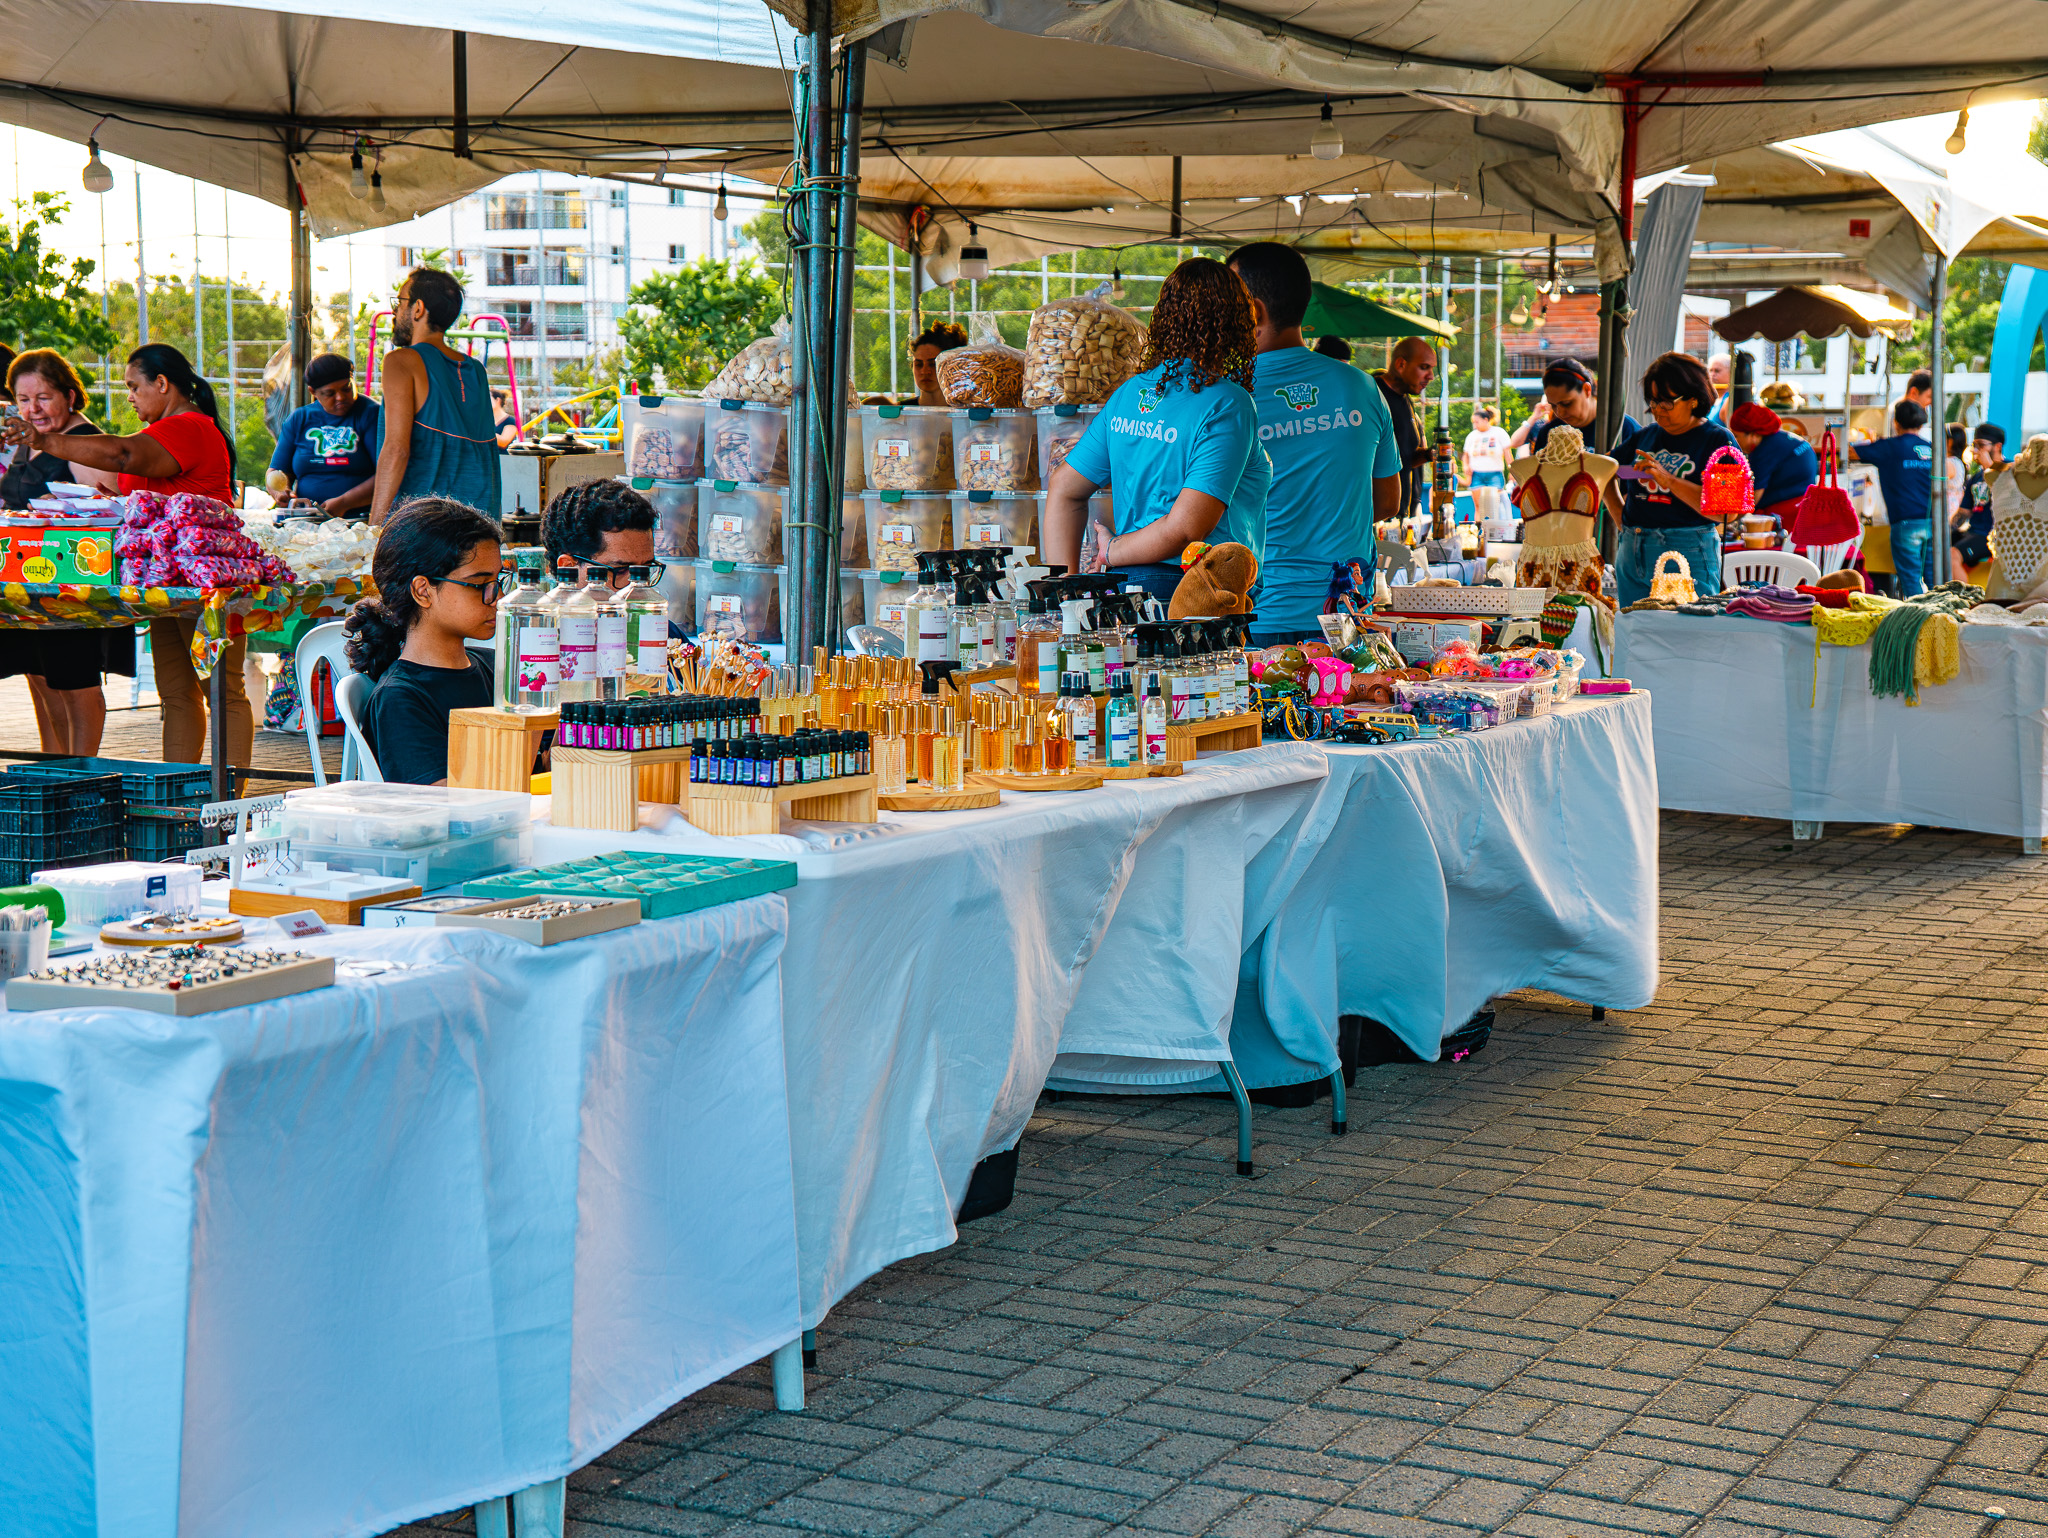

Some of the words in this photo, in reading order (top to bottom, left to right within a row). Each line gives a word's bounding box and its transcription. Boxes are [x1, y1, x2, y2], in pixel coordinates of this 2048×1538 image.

[1286, 384, 1312, 396] FEIRA
[1110, 416, 1178, 443] COMISSÃO
[1258, 407, 1363, 440] OMISSÃO
[23, 565, 54, 577] Karino
